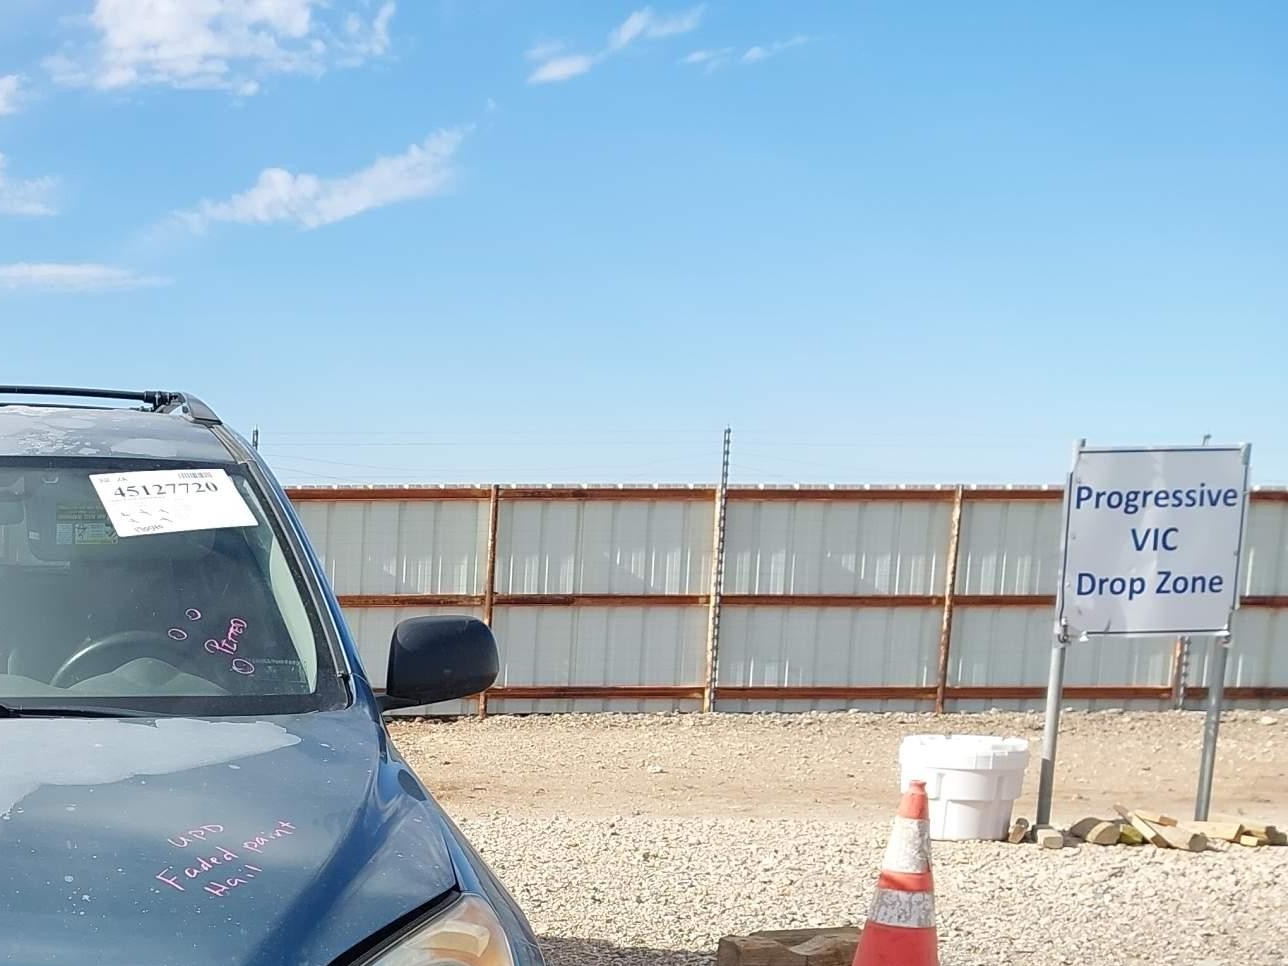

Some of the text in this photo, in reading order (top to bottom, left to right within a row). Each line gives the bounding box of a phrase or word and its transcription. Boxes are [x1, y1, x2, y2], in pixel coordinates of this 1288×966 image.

[113, 481, 219, 498] 45127720
[1075, 482, 1238, 515] Progressive
[1130, 527, 1179, 551] VIC
[1076, 571, 1224, 600] Drop Zone
